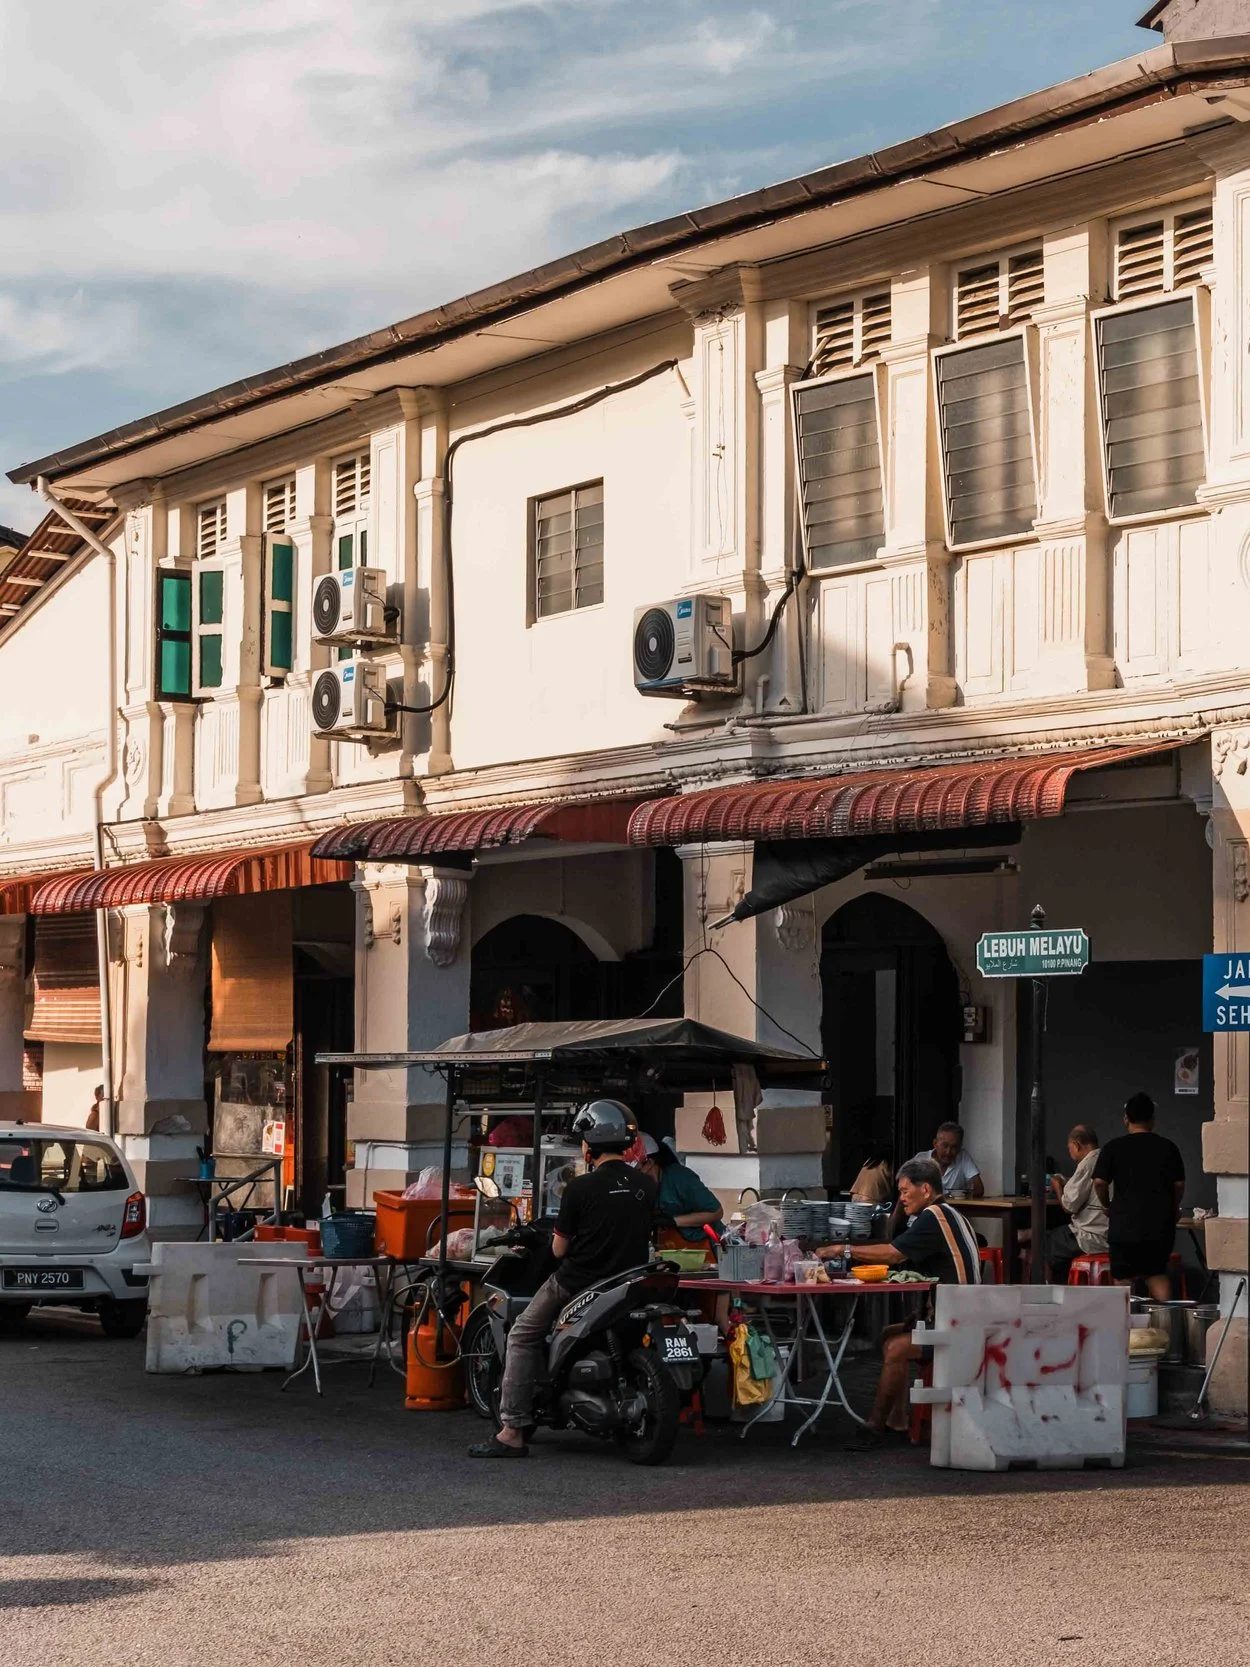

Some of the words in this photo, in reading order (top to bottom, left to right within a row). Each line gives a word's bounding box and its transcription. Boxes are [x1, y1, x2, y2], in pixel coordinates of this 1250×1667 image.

[984, 938, 1025, 958] LEBUH
[1029, 935, 1082, 956] MELAYU
[1057, 958, 1082, 968] P.PINANG
[17, 1272, 38, 1284] PNY
[41, 1272, 70, 1284] 2570
[665, 1337, 687, 1348] RAW
[666, 1346, 693, 1358] 2861
